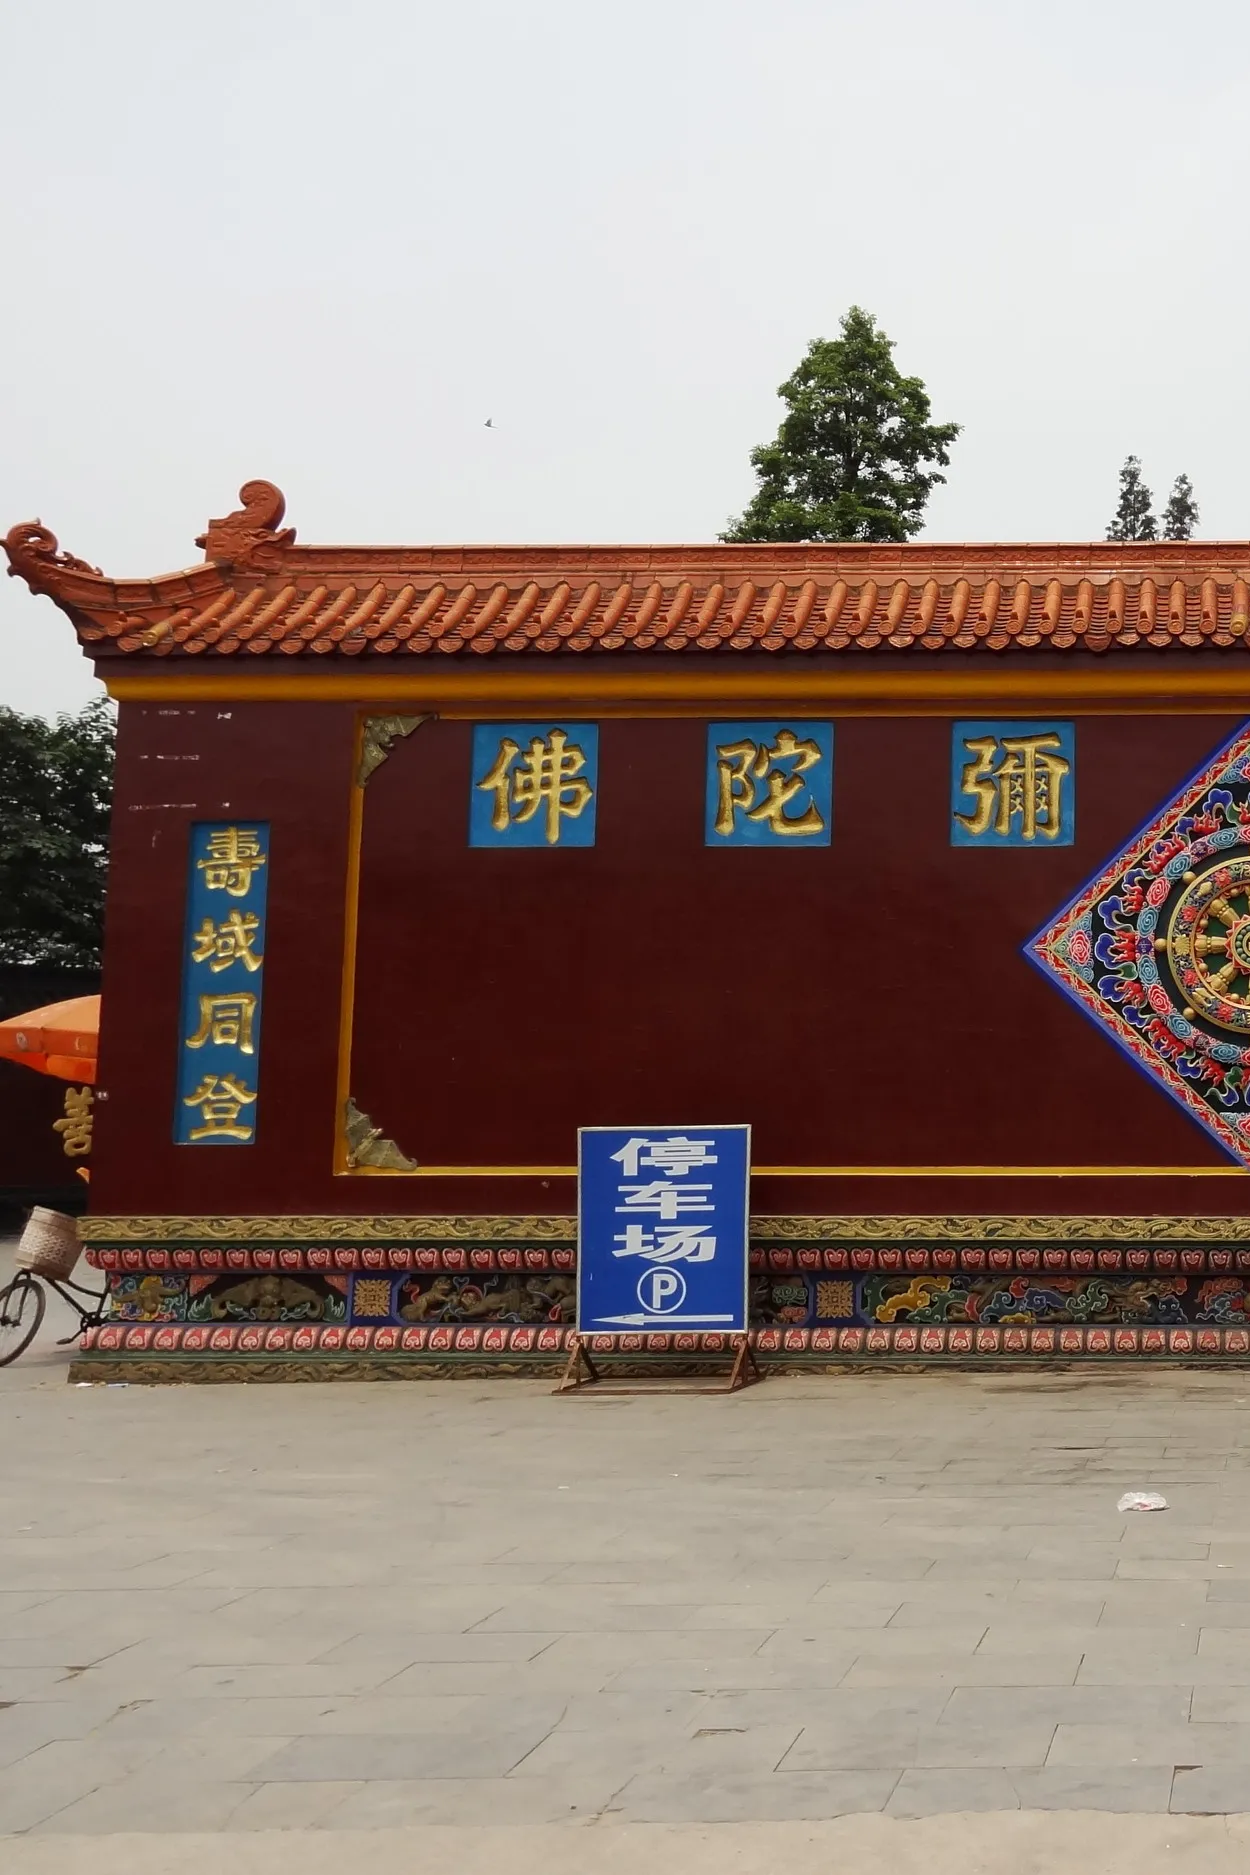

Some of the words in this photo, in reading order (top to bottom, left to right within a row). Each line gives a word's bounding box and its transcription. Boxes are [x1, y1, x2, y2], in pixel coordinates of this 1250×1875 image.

[476, 727, 595, 845] 佛
[713, 728, 826, 836] 陀
[953, 731, 1070, 841] 彌
[609, 1136, 718, 1264] 停车场
[652, 1273, 678, 1309] P
